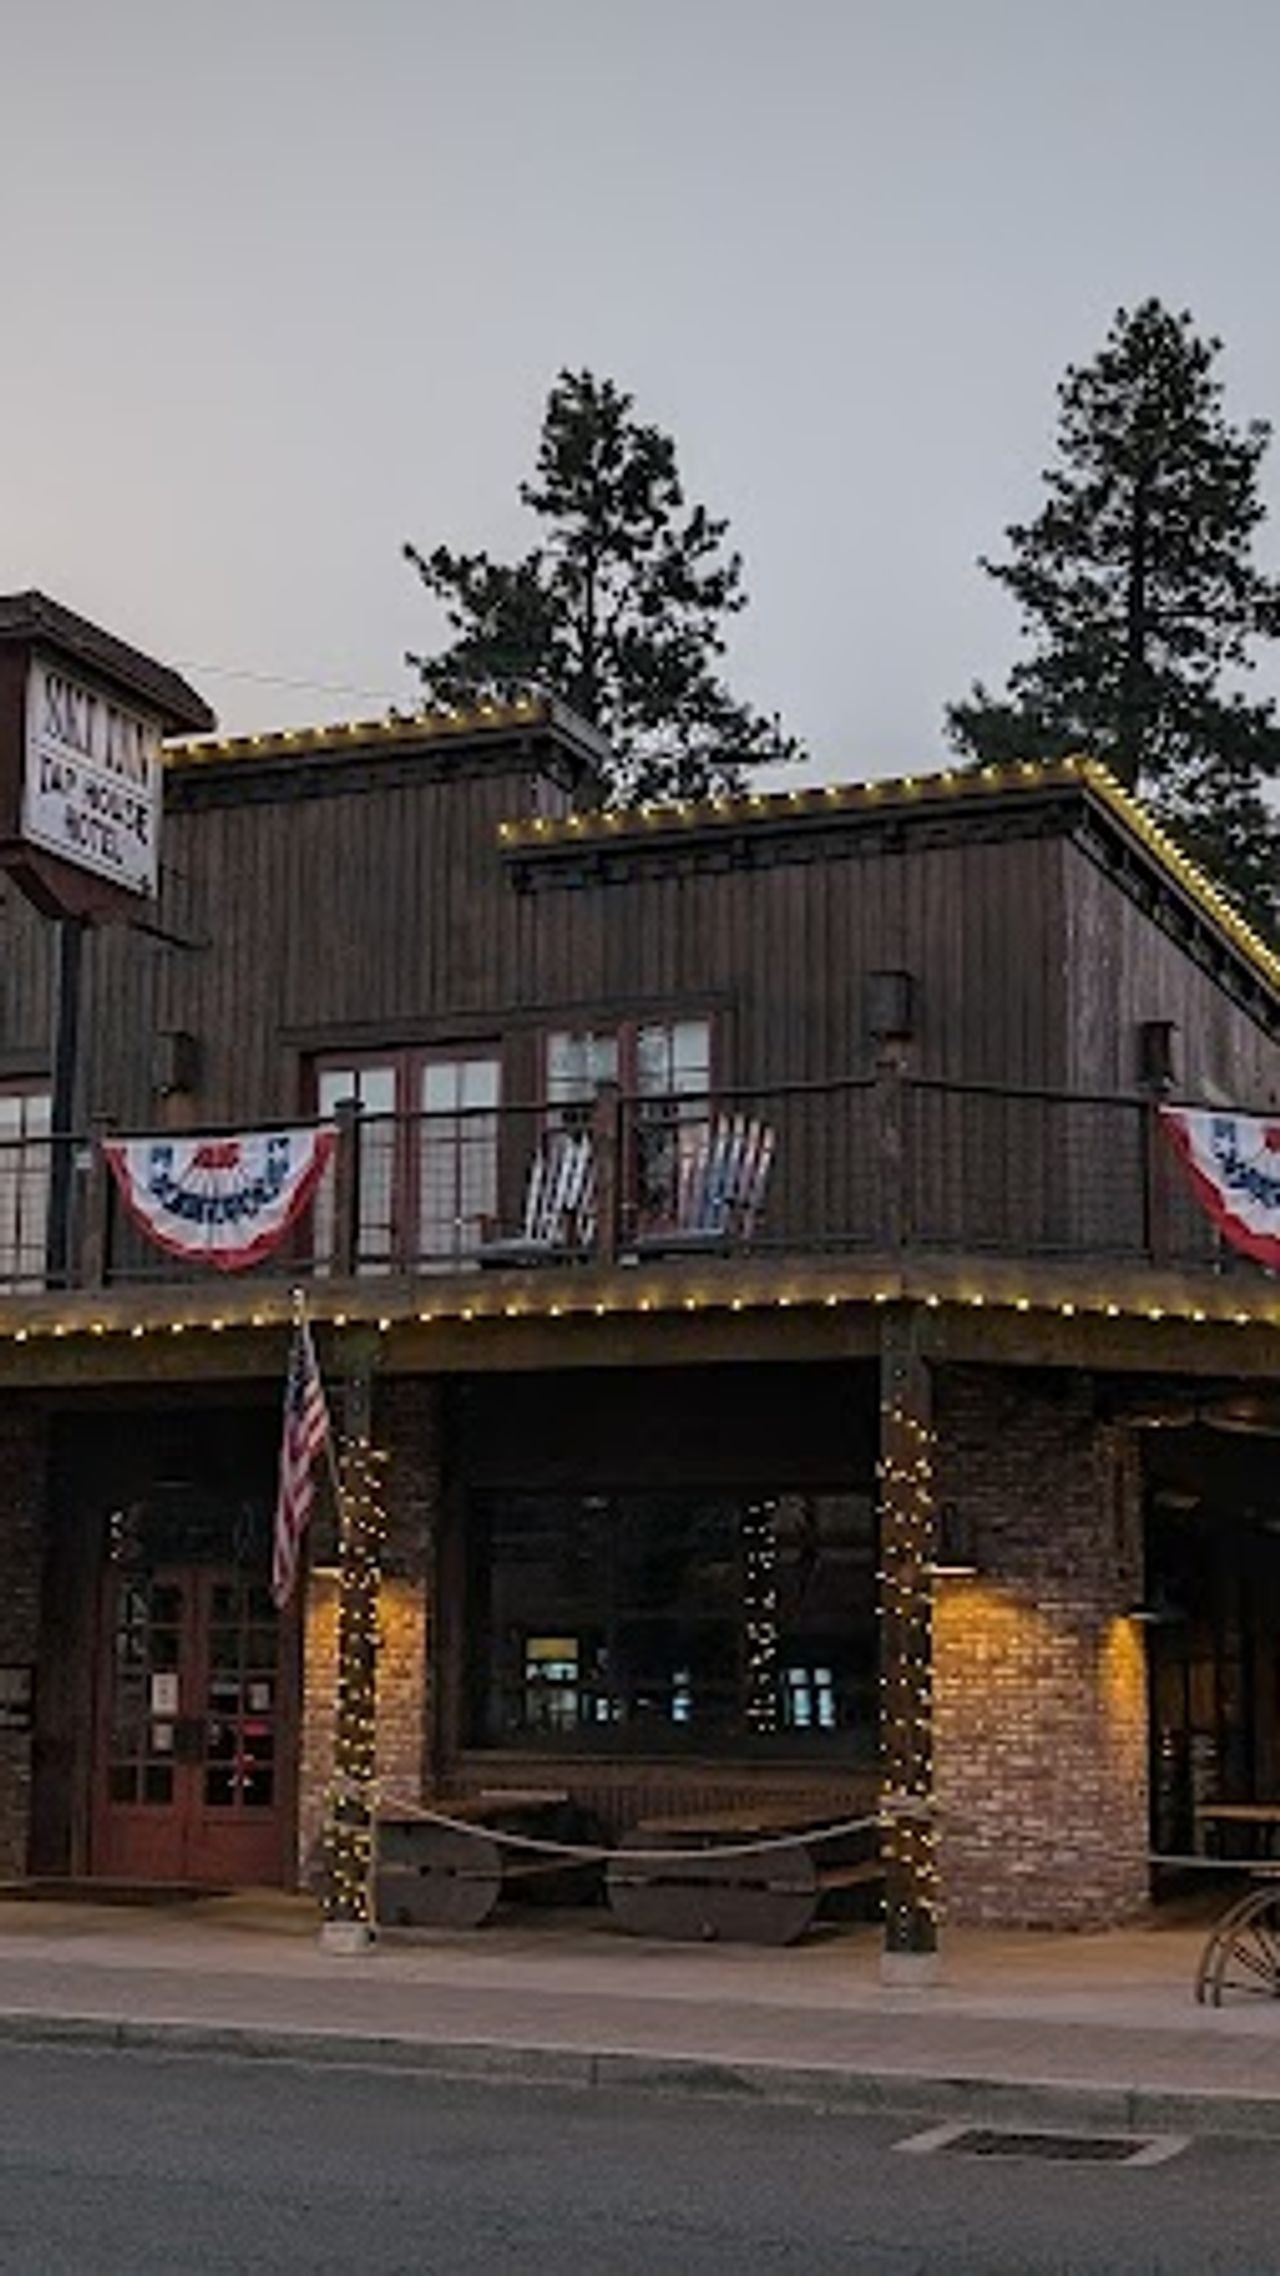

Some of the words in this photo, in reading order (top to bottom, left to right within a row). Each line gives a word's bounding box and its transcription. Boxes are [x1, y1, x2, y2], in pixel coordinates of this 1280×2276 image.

[40, 755, 77, 794] TAP
[85, 777, 148, 845] HOUSE
[65, 803, 122, 865] HOTEL
